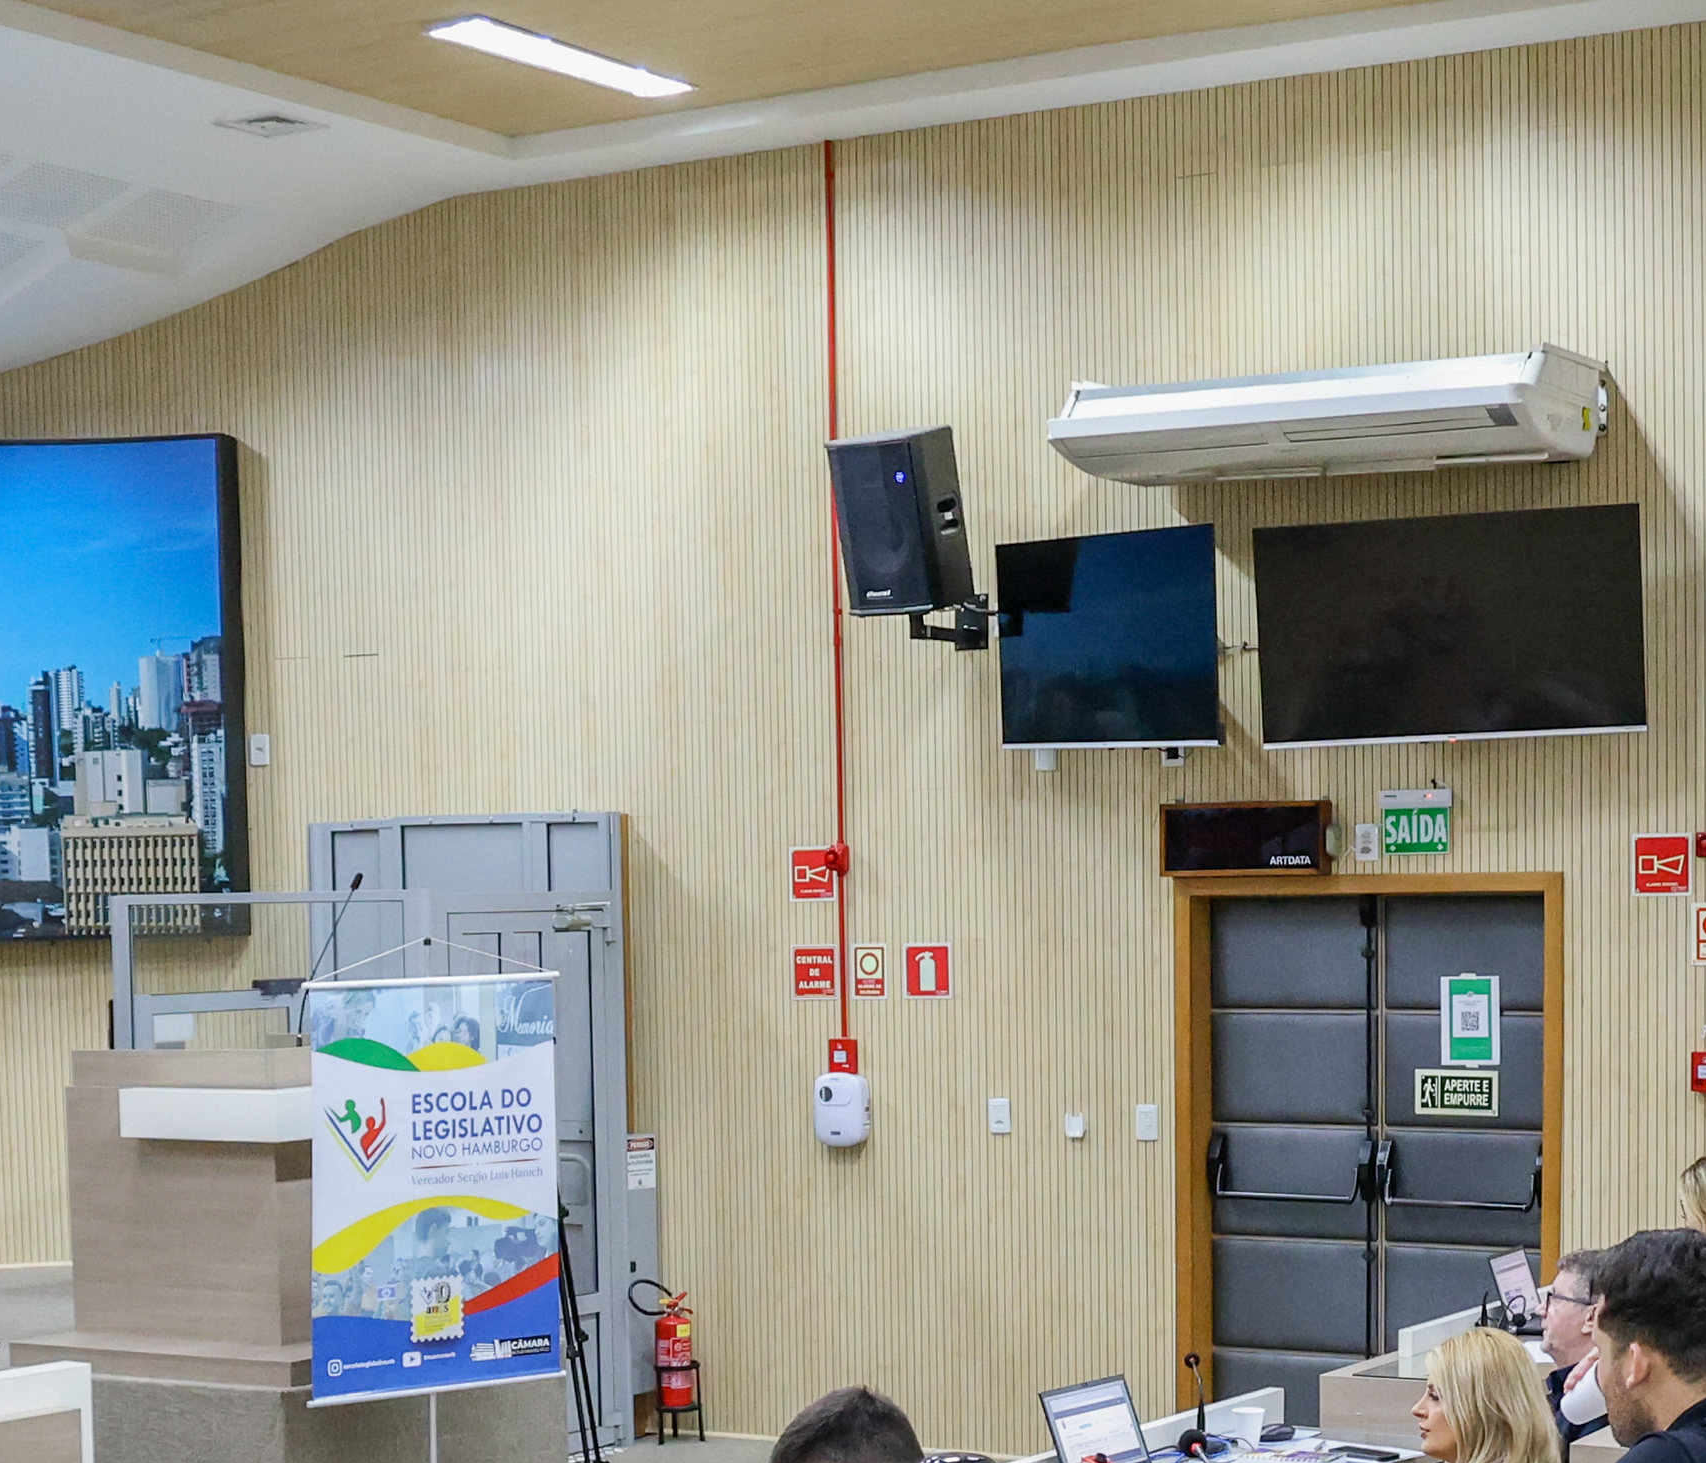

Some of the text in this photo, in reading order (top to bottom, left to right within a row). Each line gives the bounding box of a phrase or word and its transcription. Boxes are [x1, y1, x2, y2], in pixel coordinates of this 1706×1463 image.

[1385, 809, 1447, 844] SAÍDA
[1269, 855, 1311, 866] ARTDATA
[796, 956, 833, 964] CENTRAL
[809, 968, 820, 976] DE
[798, 980, 831, 989] ALARME
[1444, 1079, 1489, 1092] APERTE E
[411, 1087, 532, 1114] ESCOLA DO
[1444, 1093, 1489, 1107] EMPURRE
[412, 1113, 543, 1141] LEGISLATIVO
[411, 1137, 543, 1160] NOVO HAMBURGO
[411, 1174, 455, 1186] Vereador
[511, 1337, 550, 1351] CÂMARA
